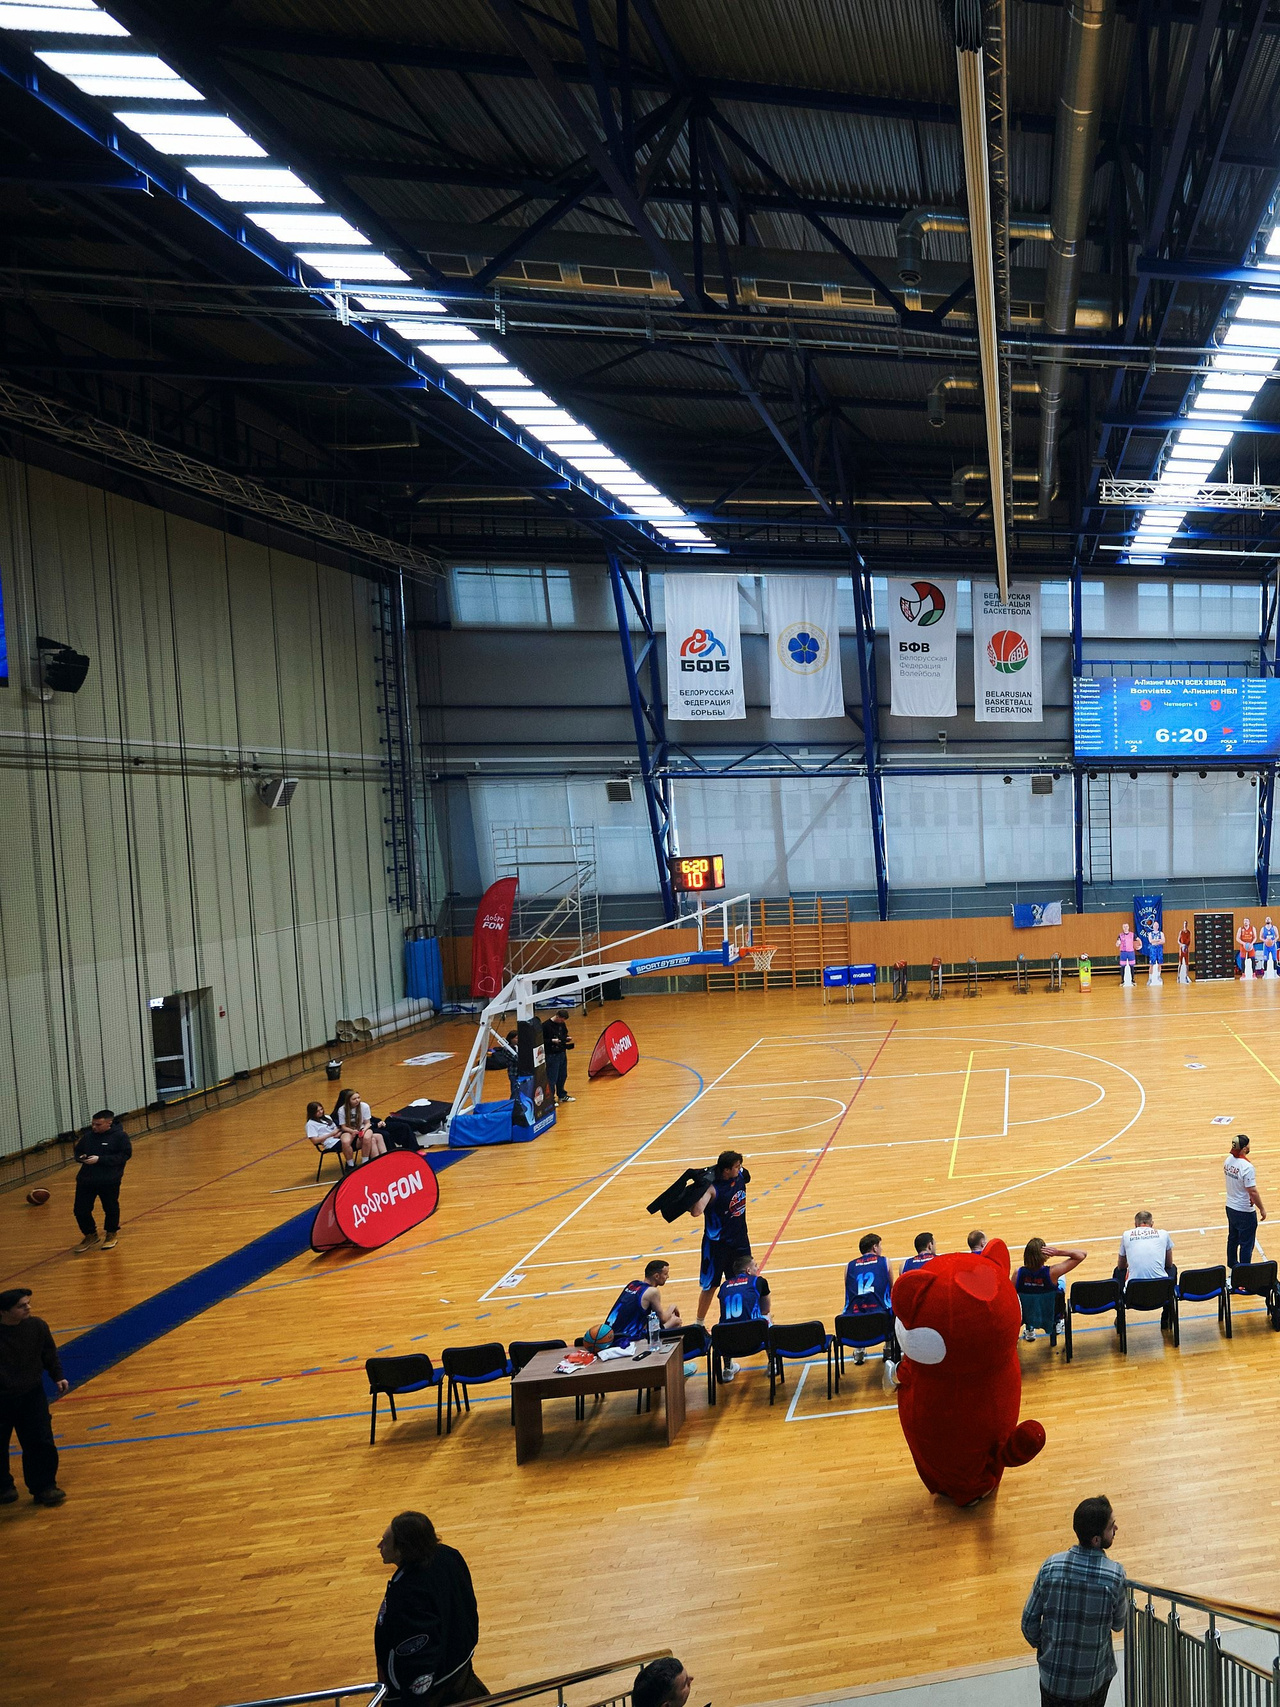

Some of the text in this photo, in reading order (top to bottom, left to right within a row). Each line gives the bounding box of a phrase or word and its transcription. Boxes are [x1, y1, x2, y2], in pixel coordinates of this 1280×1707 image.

[983, 607, 1031, 616] БАСКЕТБОЛА
[899, 641, 930, 653] БФВ
[1011, 642, 1027, 662] BBF
[899, 653, 948, 662] Белорусская
[899, 662, 941, 670] Федерация
[680, 689, 734, 697] БЕЛОРУССКАЯ
[985, 690, 1032, 698] BELARUSIAN
[683, 699, 731, 707] ФЕДЕРАЦИЯ
[984, 698, 1033, 706] BASKETBALL
[1140, 699, 1152, 711] 9
[1210, 699, 1222, 711] 9
[985, 706, 1033, 714] FEDERATION
[1155, 728, 1208, 743] 6:20
[1130, 745, 1138, 753] 2
[1225, 744, 1233, 752] 2
[681, 859, 709, 873] 6:20
[687, 871, 703, 887] 10
[483, 912, 505, 922] Добро
[482, 921, 504, 930] FON
[856, 1271, 875, 1295] 12
[725, 1293, 743, 1320] 10
